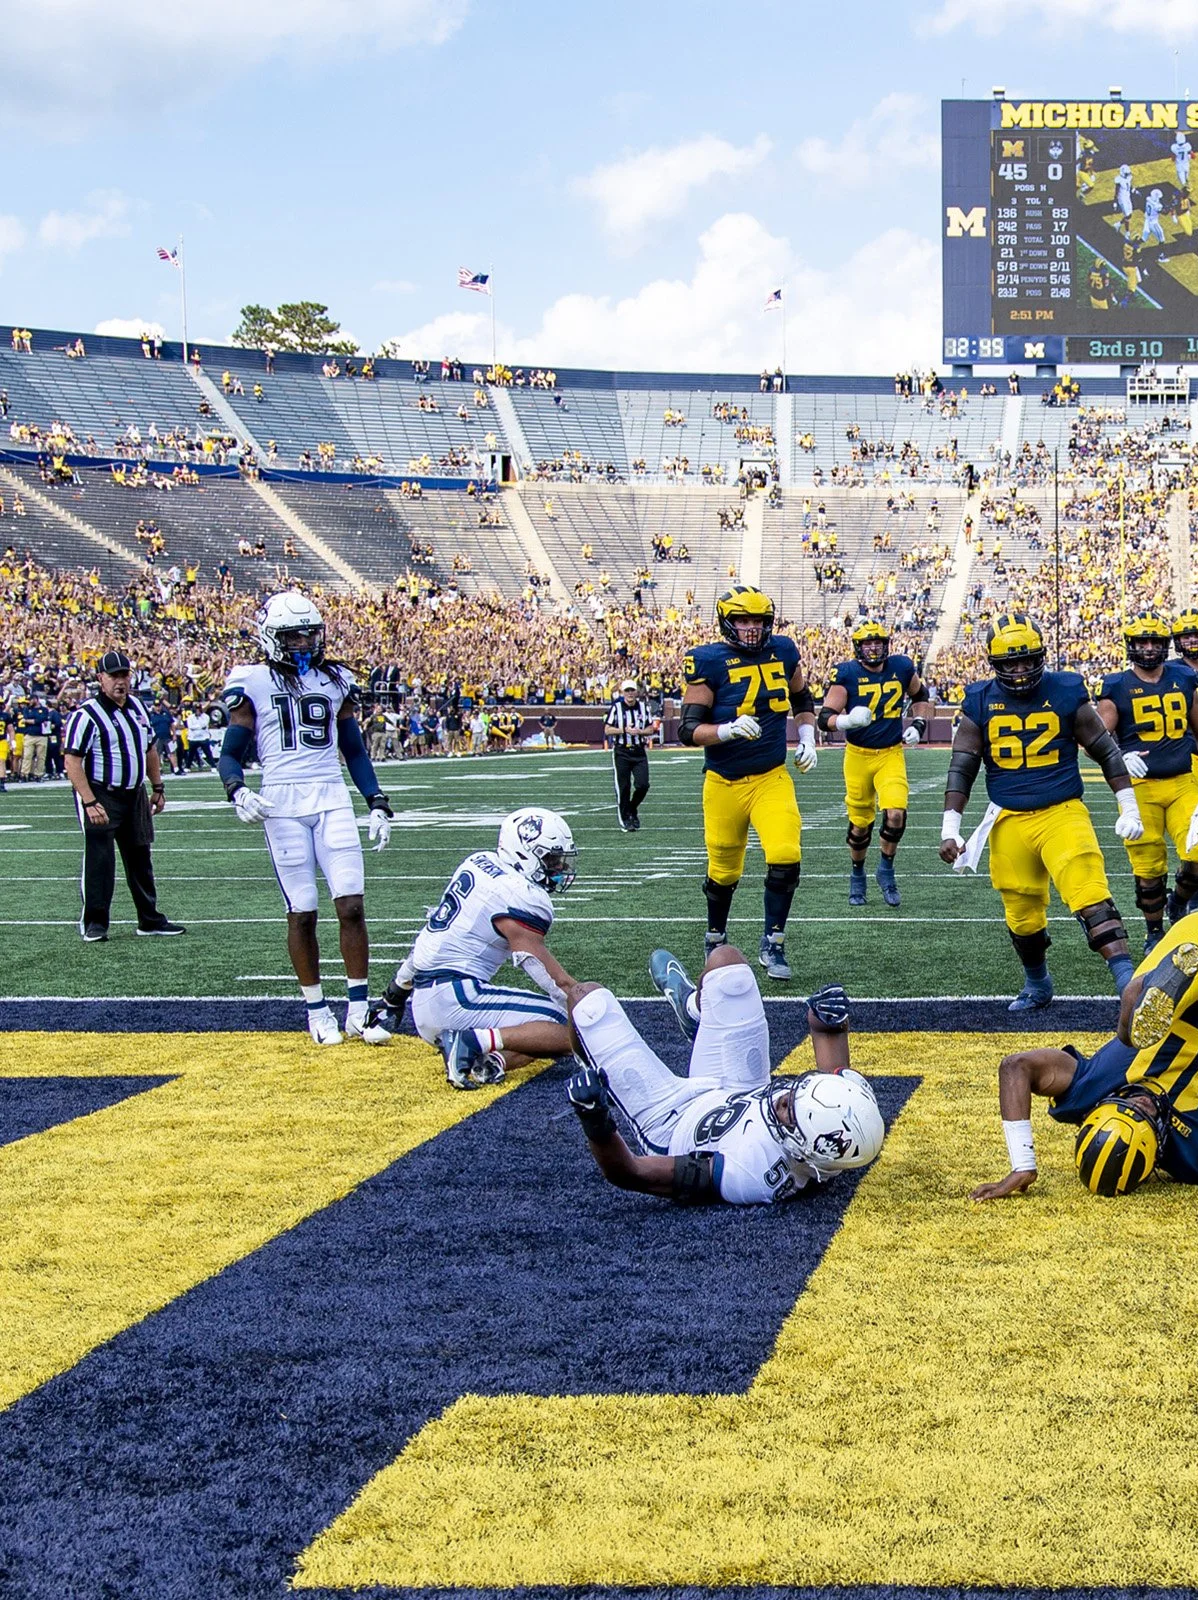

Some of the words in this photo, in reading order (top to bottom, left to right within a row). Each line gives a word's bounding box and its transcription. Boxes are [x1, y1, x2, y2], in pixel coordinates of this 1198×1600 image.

[1000, 102, 1179, 129] MICHIGAN
[998, 163, 1028, 181] 45
[1047, 163, 1063, 181] 0
[1014, 183, 1035, 192] POSS
[1025, 196, 1041, 205] TOL
[1047, 196, 1055, 205] 2
[997, 207, 1018, 219] 136
[1052, 207, 1069, 219] 83
[946, 206, 987, 238] M
[997, 221, 1018, 232] 242
[1025, 222, 1042, 230] PASS
[1053, 221, 1068, 232] 17
[997, 234, 1018, 245] 378
[1023, 236, 1044, 244] TOTAL
[1050, 234, 1070, 245] 100
[1000, 247, 1015, 259] 21
[1028, 249, 1048, 257] DOWN
[1056, 247, 1065, 259] 6
[996, 261, 1018, 272] 5/8
[1029, 262, 1049, 270] DOWN
[1049, 261, 1071, 272] 2/11
[996, 273, 1020, 285] 2/14
[1025, 289, 1042, 297] POSS
[1010, 309, 1033, 320] 2:51
[1035, 309, 1054, 320] PM
[1024, 342, 1045, 359] M
[1089, 340, 1123, 358] 3rd
[1125, 344, 1136, 358] &
[1140, 340, 1163, 358] 10
[728, 661, 790, 718] 75
[857, 680, 903, 722] 72
[270, 692, 334, 752] 19
[1131, 692, 1188, 742] 58
[988, 711, 1061, 770] 62
[426, 869, 475, 934] 6
